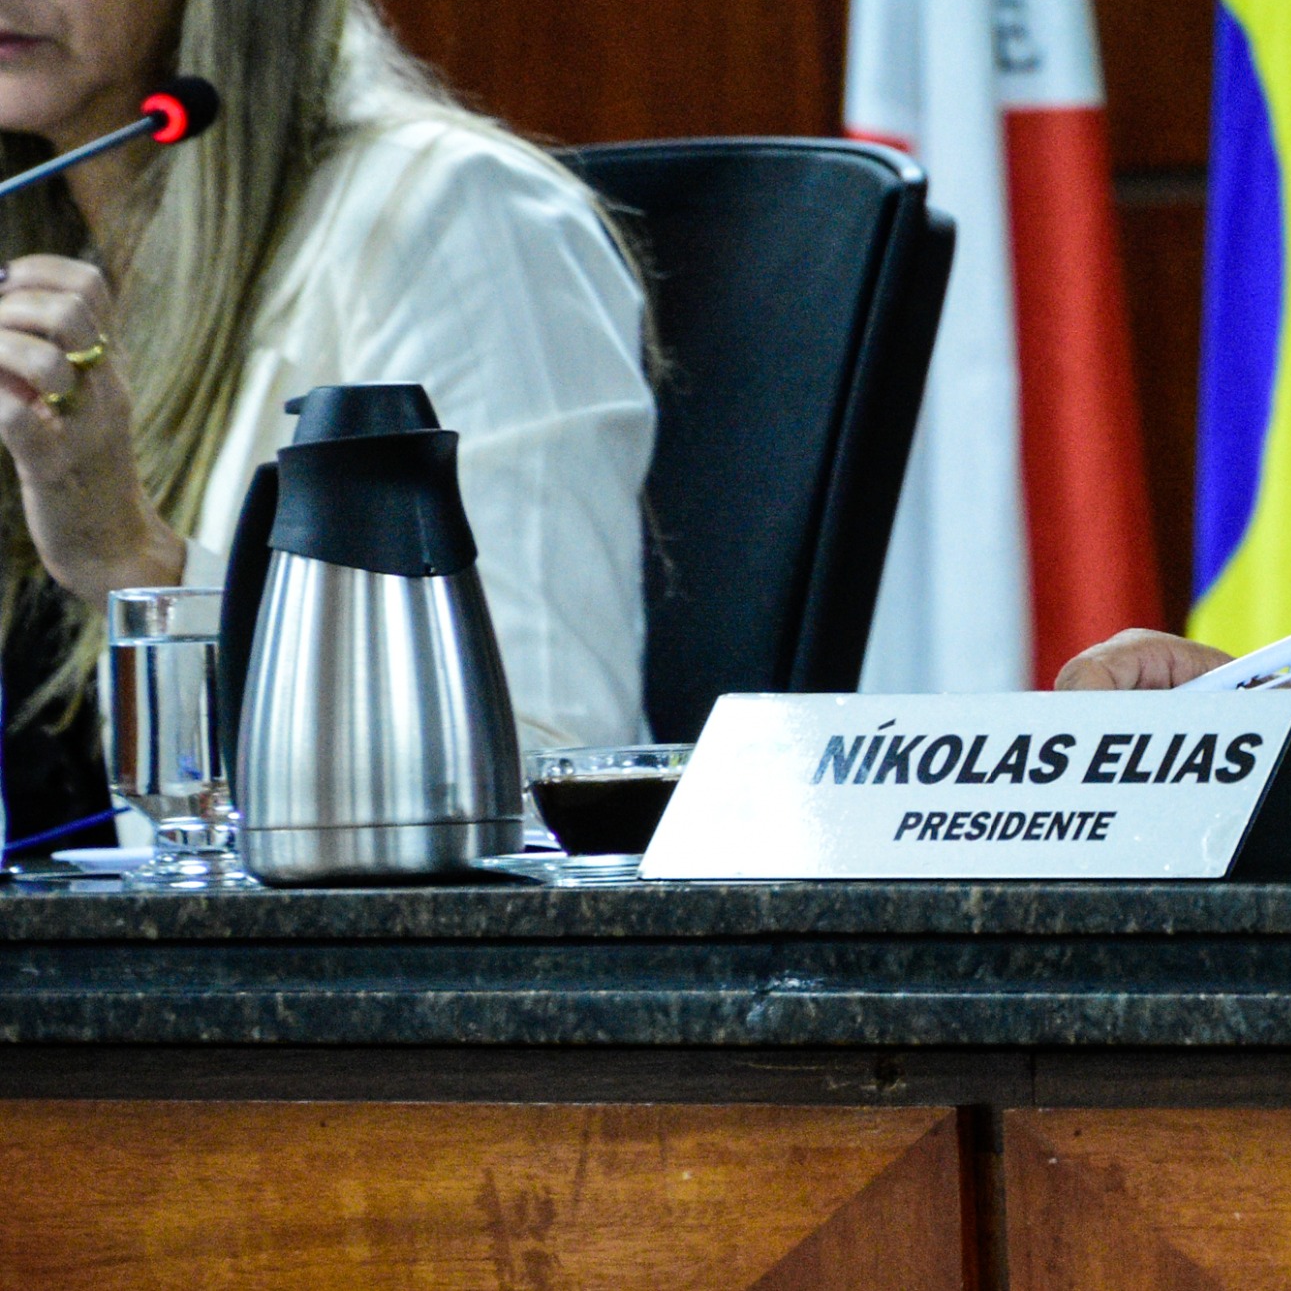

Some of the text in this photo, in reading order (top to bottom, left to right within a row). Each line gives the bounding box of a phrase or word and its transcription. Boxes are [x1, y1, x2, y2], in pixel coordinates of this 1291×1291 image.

[811, 718, 1264, 785] NÍKOLAS ELIAS
[893, 811, 1117, 841] PRESIDENTE
